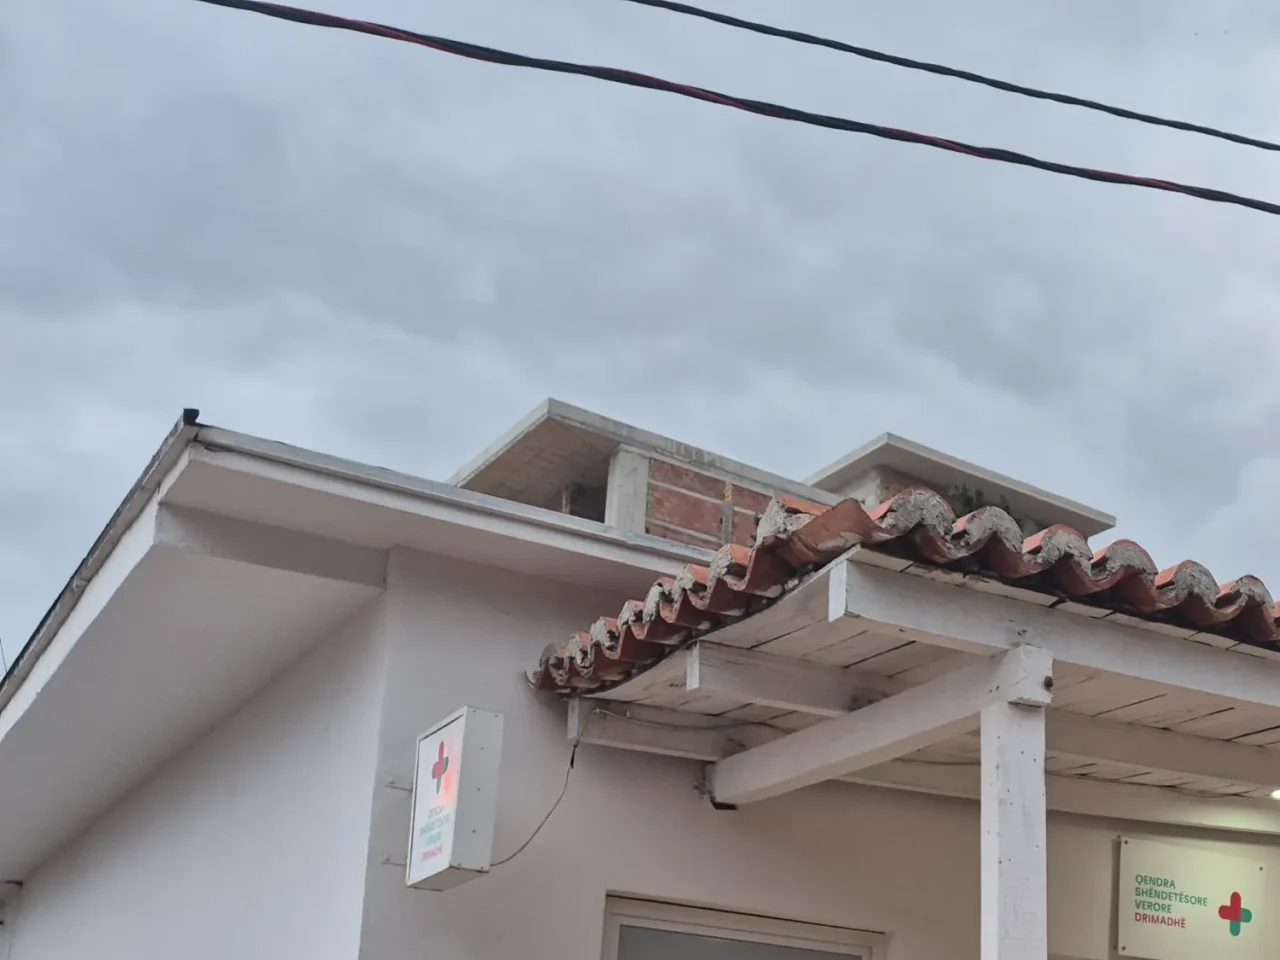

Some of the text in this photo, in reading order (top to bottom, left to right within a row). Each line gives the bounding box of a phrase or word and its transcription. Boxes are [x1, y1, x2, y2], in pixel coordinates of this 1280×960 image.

[1135, 874, 1176, 889] QENDRA
[1135, 887, 1208, 906] SHËNDETËSORE
[1135, 899, 1172, 914] VERORE
